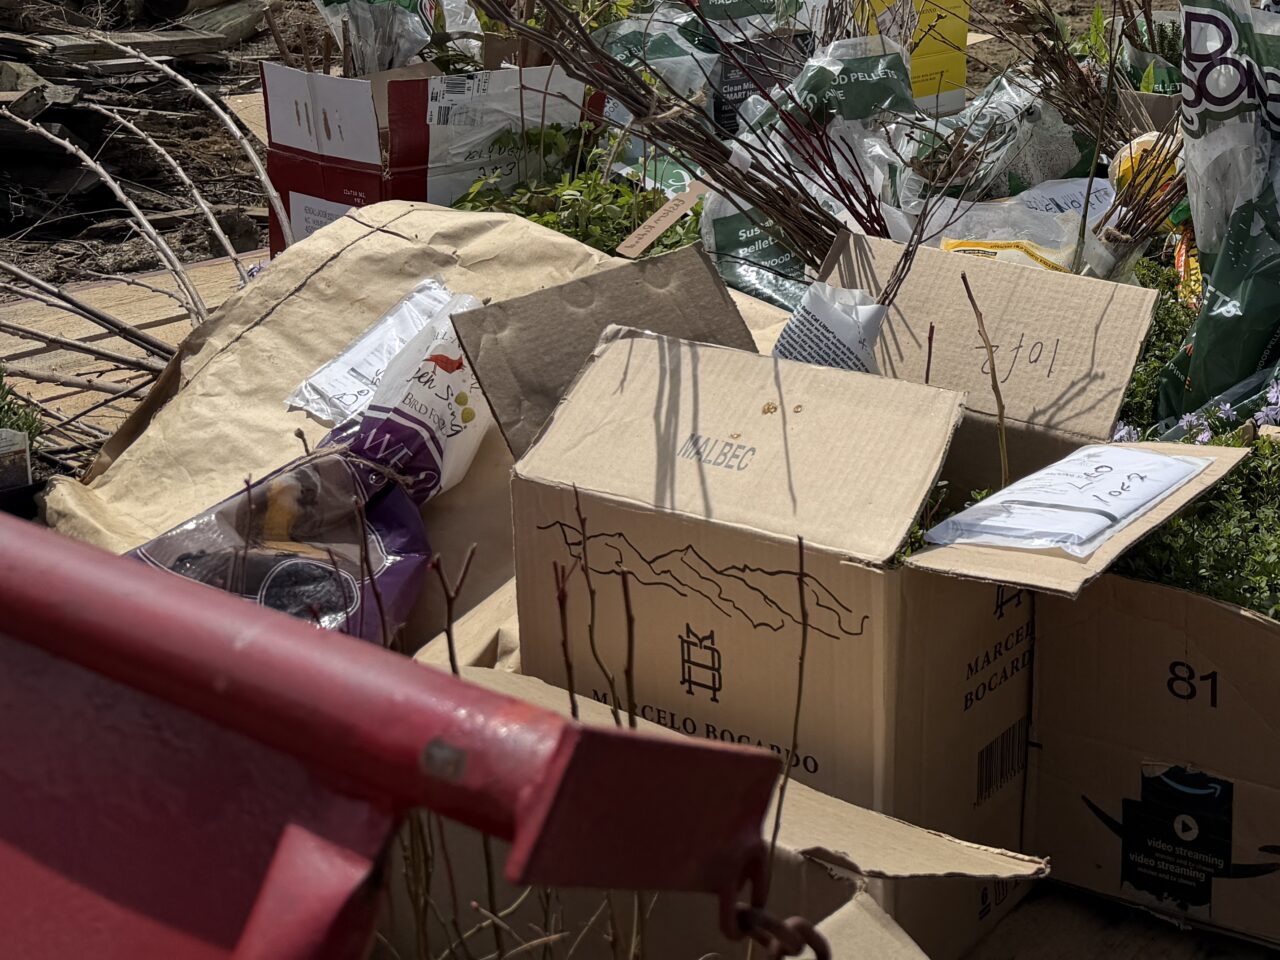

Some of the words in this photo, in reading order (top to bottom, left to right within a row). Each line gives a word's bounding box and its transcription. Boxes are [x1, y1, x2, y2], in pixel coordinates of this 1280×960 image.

[722, 84, 742, 92] Clean
[1001, 332, 1043, 384] of
[676, 432, 757, 472] MALBEC
[966, 621, 1033, 680] MARCEL
[963, 648, 1032, 712] BOCARD
[1167, 661, 1219, 708] 81
[592, 688, 697, 735] MCELO
[1129, 852, 1155, 866] video
[1157, 860, 1206, 881] streaming
[1147, 837, 1173, 851] video
[1174, 846, 1225, 868] streaming
